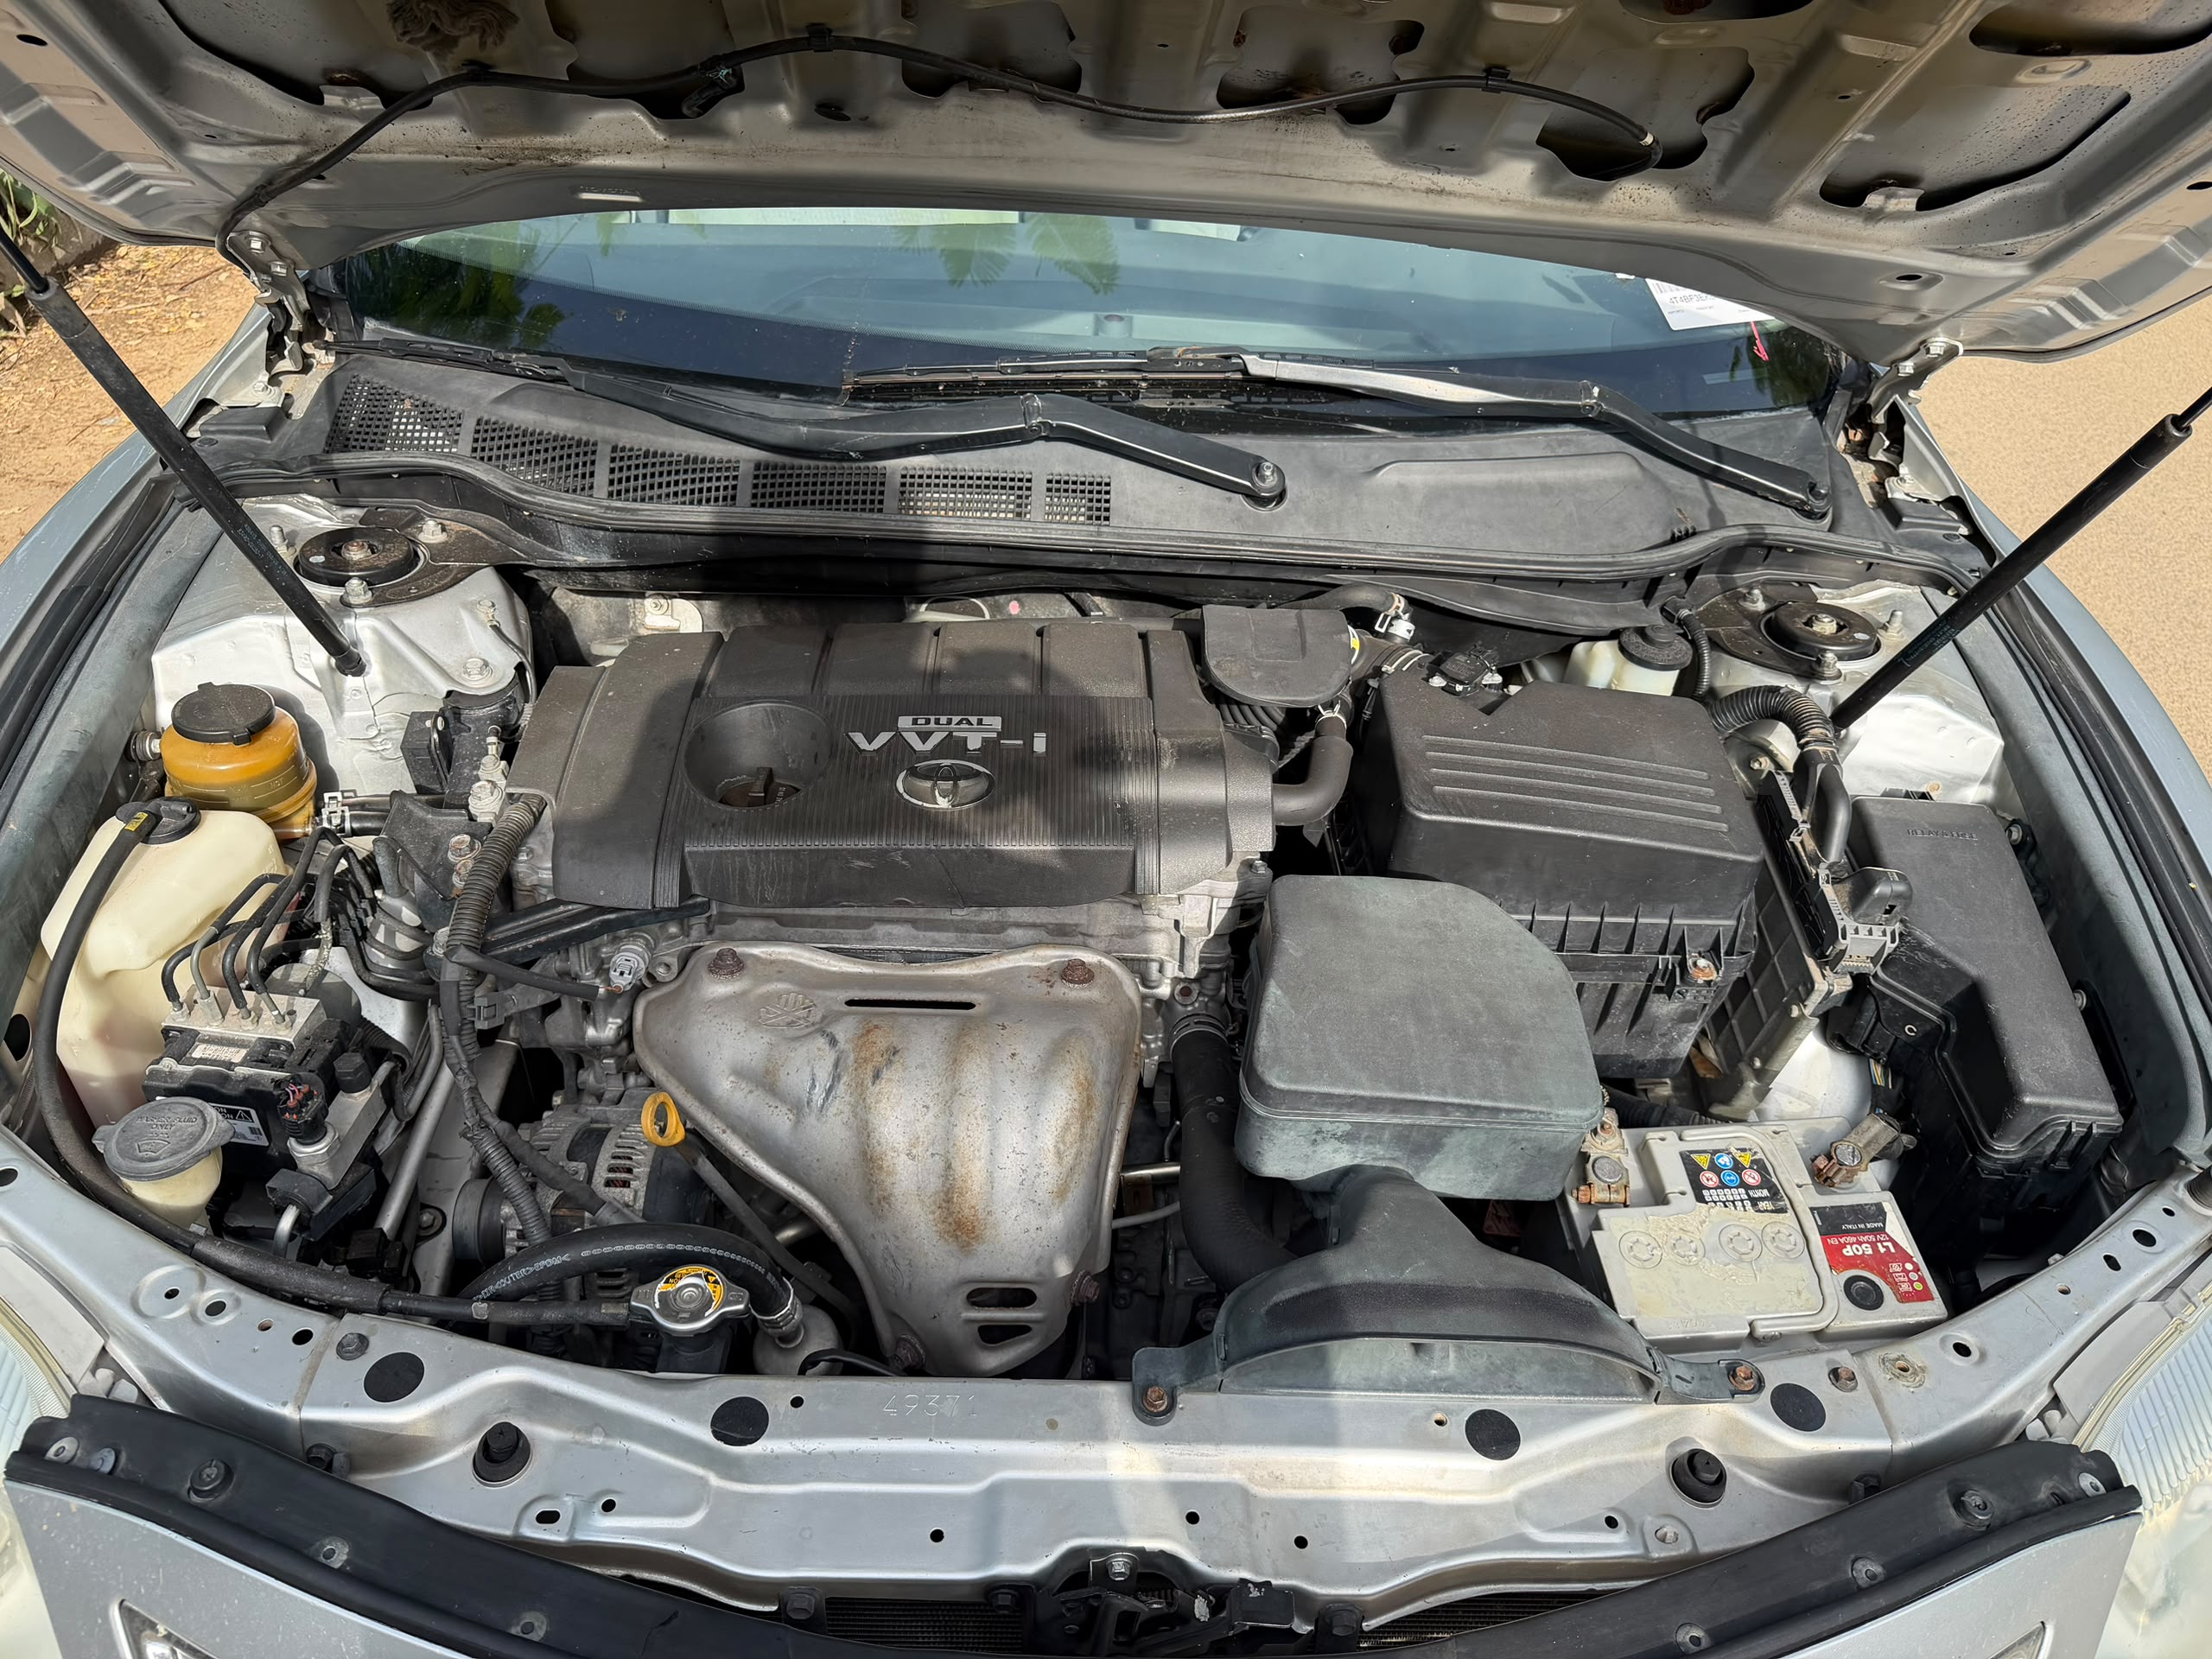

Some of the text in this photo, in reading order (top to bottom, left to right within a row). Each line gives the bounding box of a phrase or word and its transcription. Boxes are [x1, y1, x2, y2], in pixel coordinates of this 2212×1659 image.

[911, 716, 994, 727] DUAL
[1906, 829, 1939, 837] RELAY
[1951, 831, 1978, 841] FUSE
[1748, 1189, 1770, 1198] MONTH
[1841, 1242, 1896, 1256] L1 50P
[882, 1393, 978, 1417] 49371
